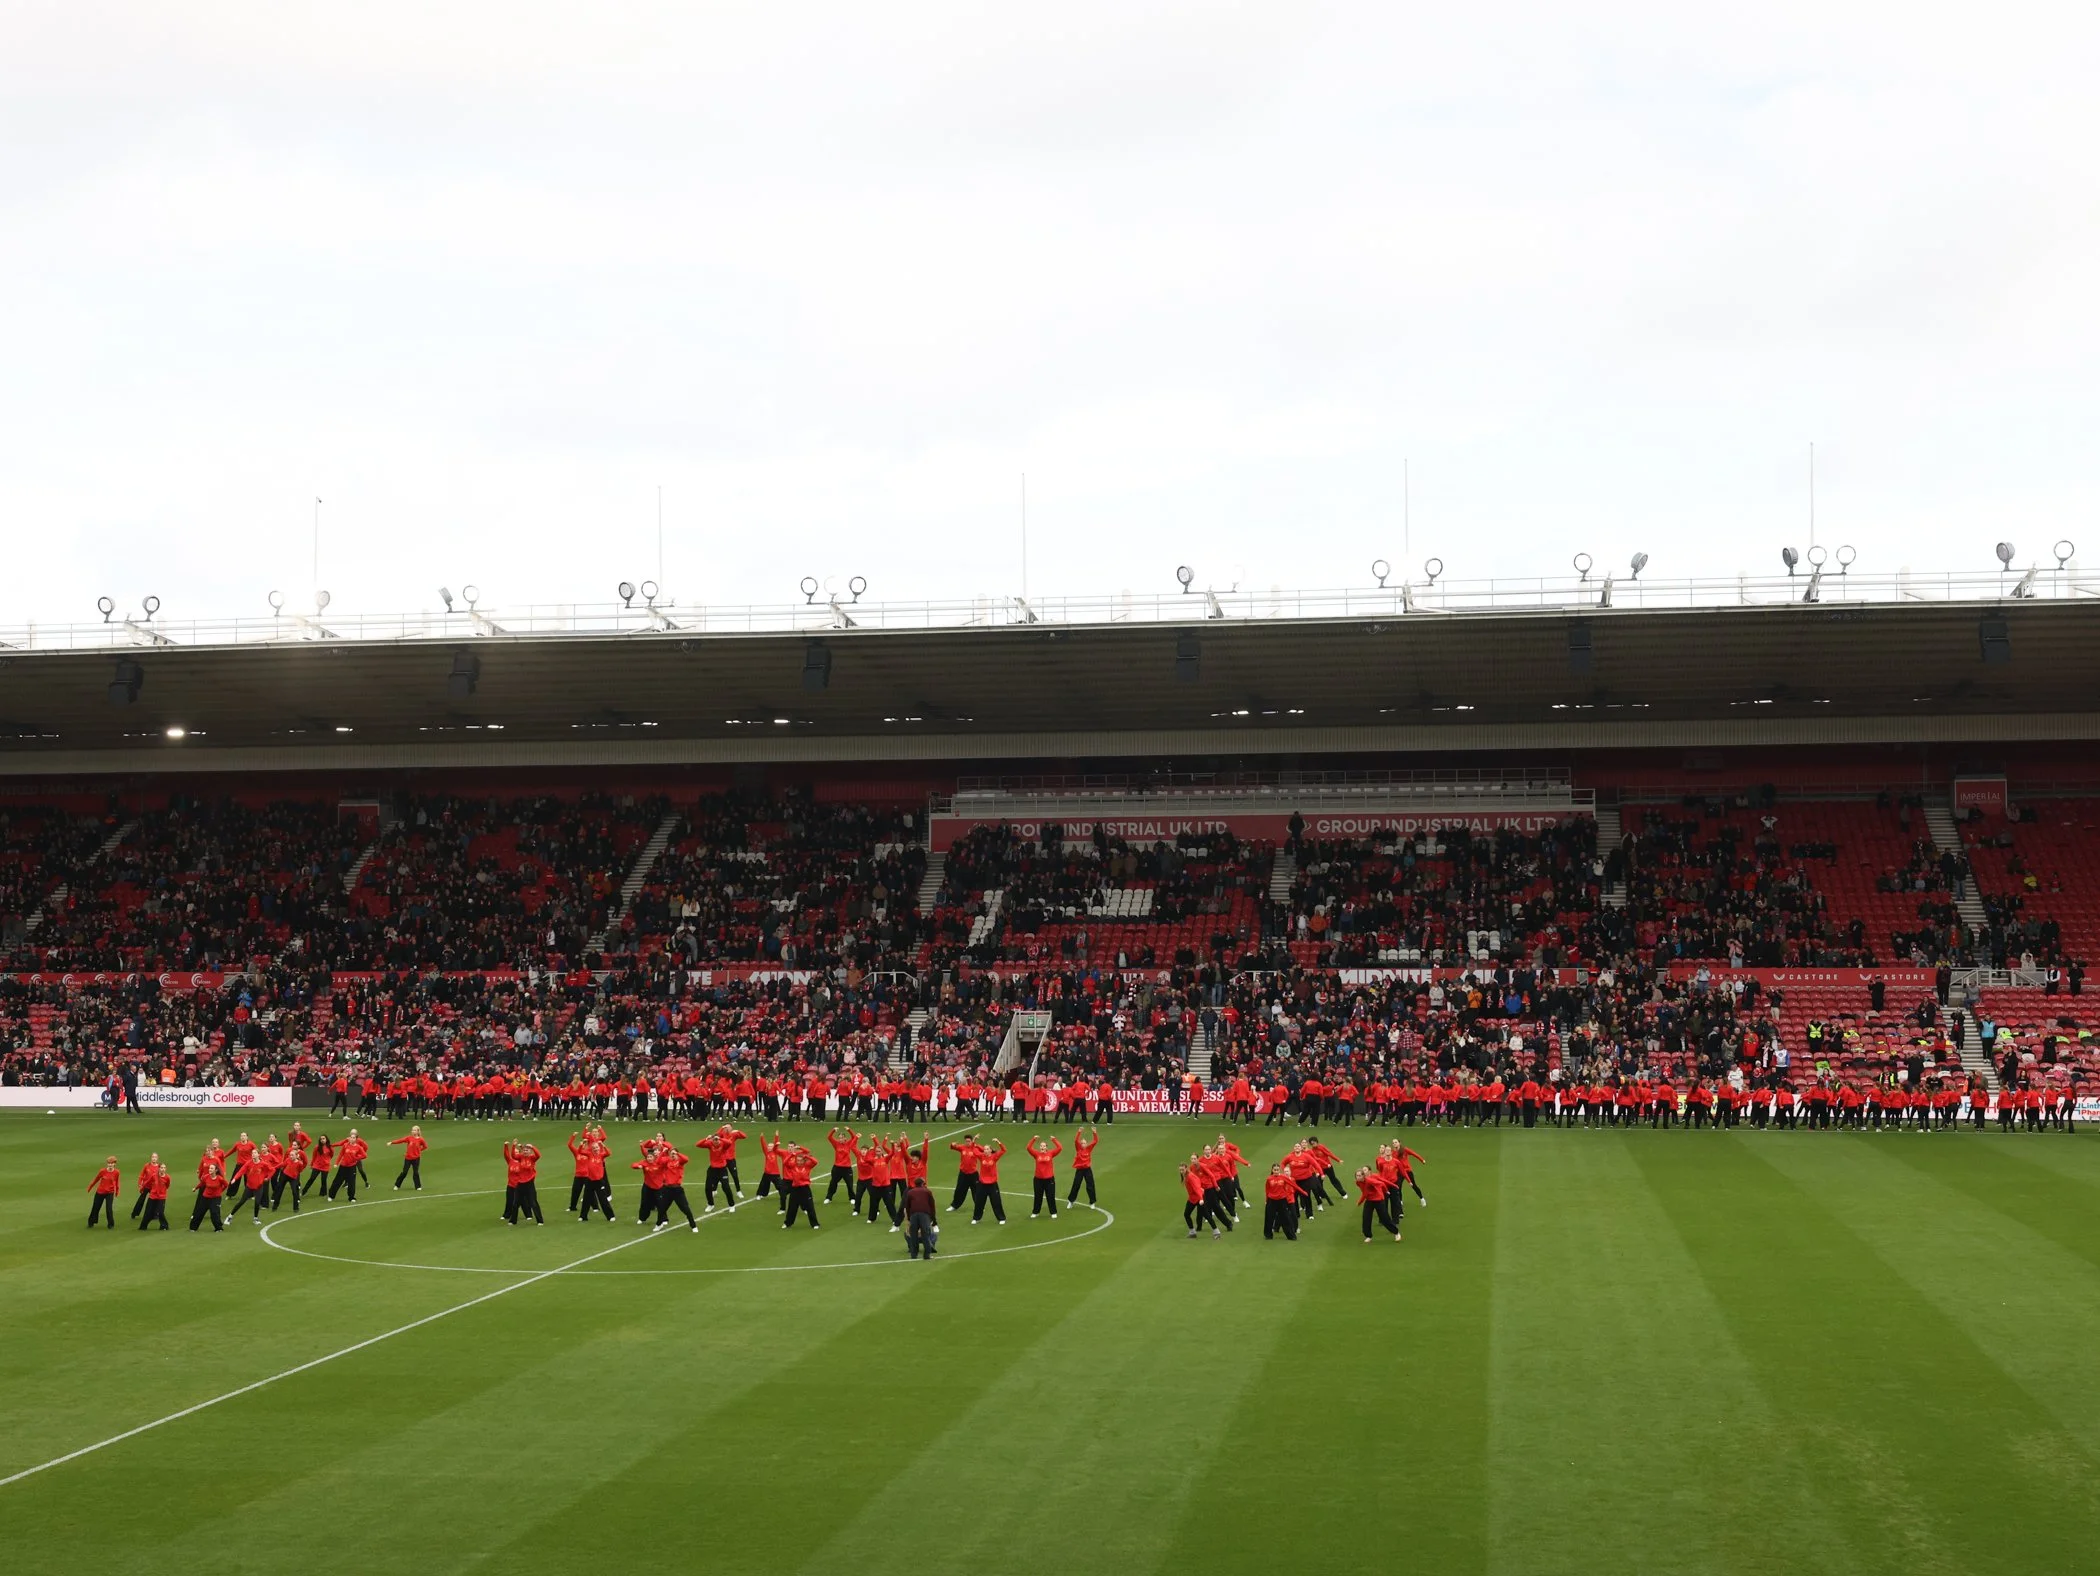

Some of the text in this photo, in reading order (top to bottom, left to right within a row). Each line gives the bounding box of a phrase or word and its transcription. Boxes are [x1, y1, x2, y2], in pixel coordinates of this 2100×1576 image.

[1960, 791, 2001, 801] IMPERIAL
[1316, 819, 1381, 833] GROUP
[213, 1092, 255, 1105] College
[1161, 1090, 1225, 1102] BSIESS
